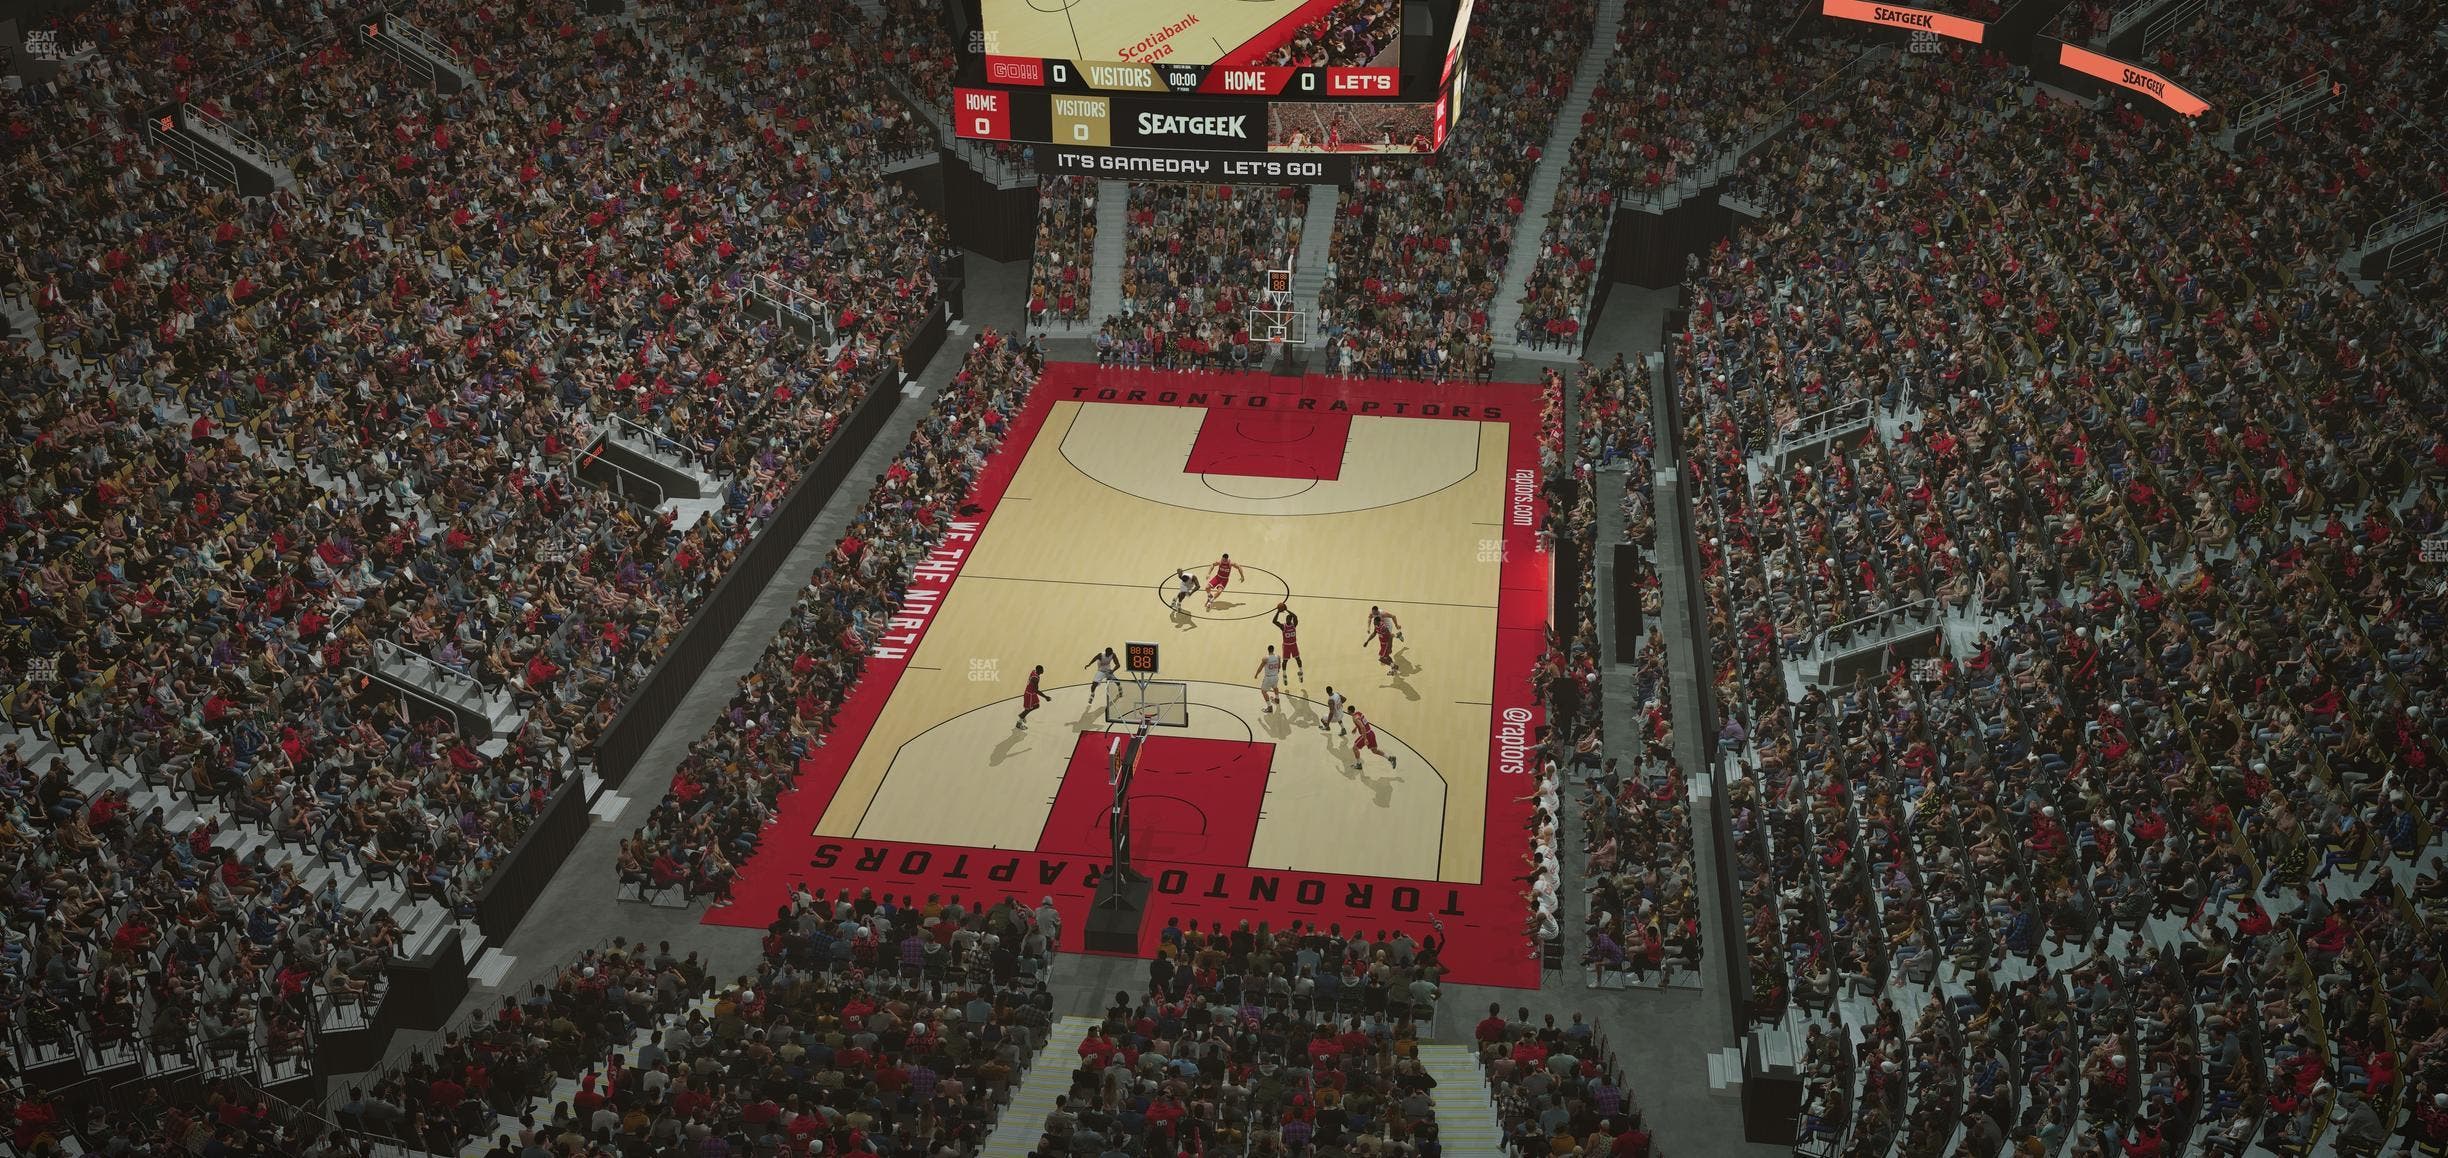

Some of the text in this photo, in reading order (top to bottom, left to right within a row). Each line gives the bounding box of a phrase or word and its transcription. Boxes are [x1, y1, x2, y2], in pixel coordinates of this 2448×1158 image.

[1874, 7, 1933, 28] SEATGEEK
[1118, 13, 1200, 63] Scotiabank
[993, 62, 1039, 80] GO!!!
[1053, 65, 1067, 83] 0
[1090, 66, 1152, 88] VISITORS
[1169, 72, 1197, 87] 00:00
[1224, 71, 1266, 91] HOME
[1301, 72, 1315, 91] 0
[1334, 75, 1391, 90] LET'S
[2123, 69, 2165, 98] SEATGEEK
[966, 94, 997, 112] HOME
[1056, 99, 1106, 118] VISITORS
[975, 118, 990, 134] 0
[1073, 124, 1089, 141] 0
[1138, 112, 1247, 139] SEATGEEK
[1057, 153, 1322, 177] IT'S GAMEDAY LET'S GO!
[1071, 386, 1502, 419] TORONTO RAPTORS
[1510, 469, 1538, 526] raptors.com
[871, 521, 980, 659] WE THE NORTH
[1130, 646, 1141, 655] 88
[1133, 655, 1152, 669] 88
[1495, 707, 1533, 774] @raptors
[810, 844, 1465, 916] TORONTO RAPTORS
